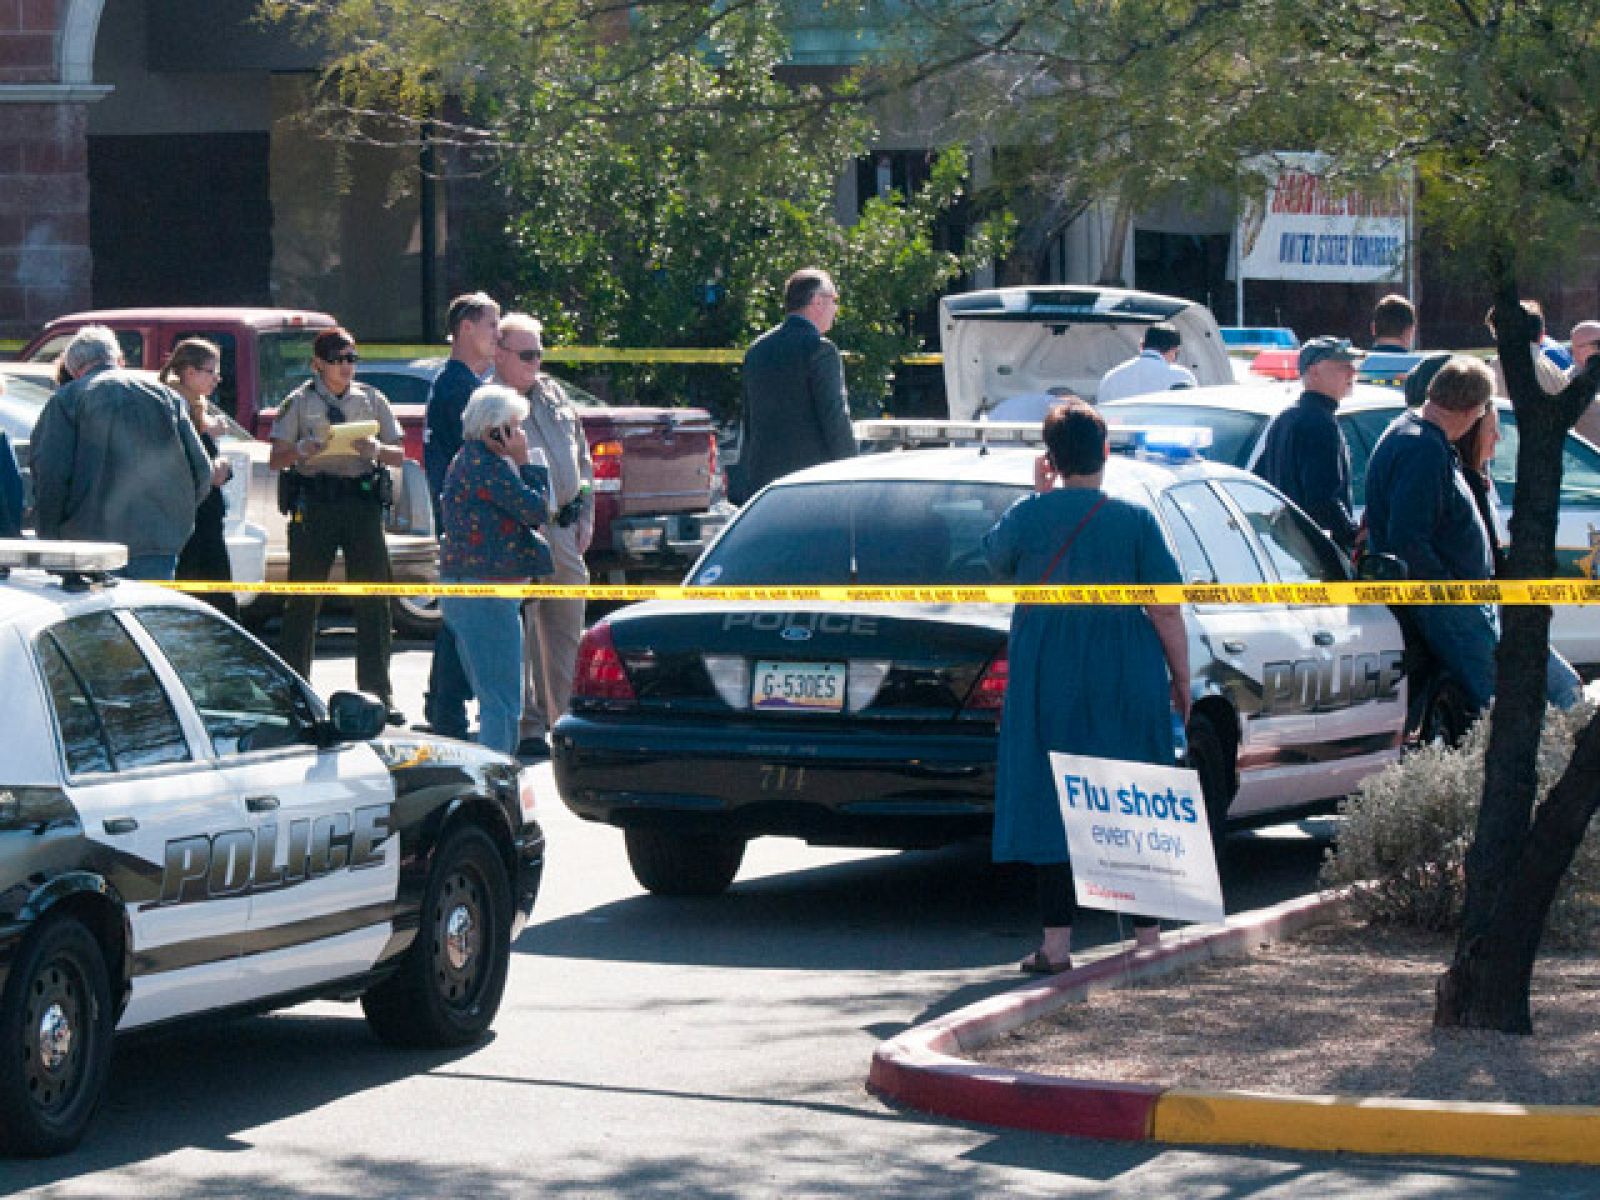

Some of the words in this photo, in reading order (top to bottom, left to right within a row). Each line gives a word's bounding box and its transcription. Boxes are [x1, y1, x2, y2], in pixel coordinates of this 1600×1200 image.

[721, 612, 879, 636] POLICE
[1262, 650, 1403, 715] POLICE
[1064, 774, 1111, 812] Flu
[1116, 782, 1198, 824] shots
[160, 802, 392, 906] POLICE
[1092, 824, 1143, 854] every
